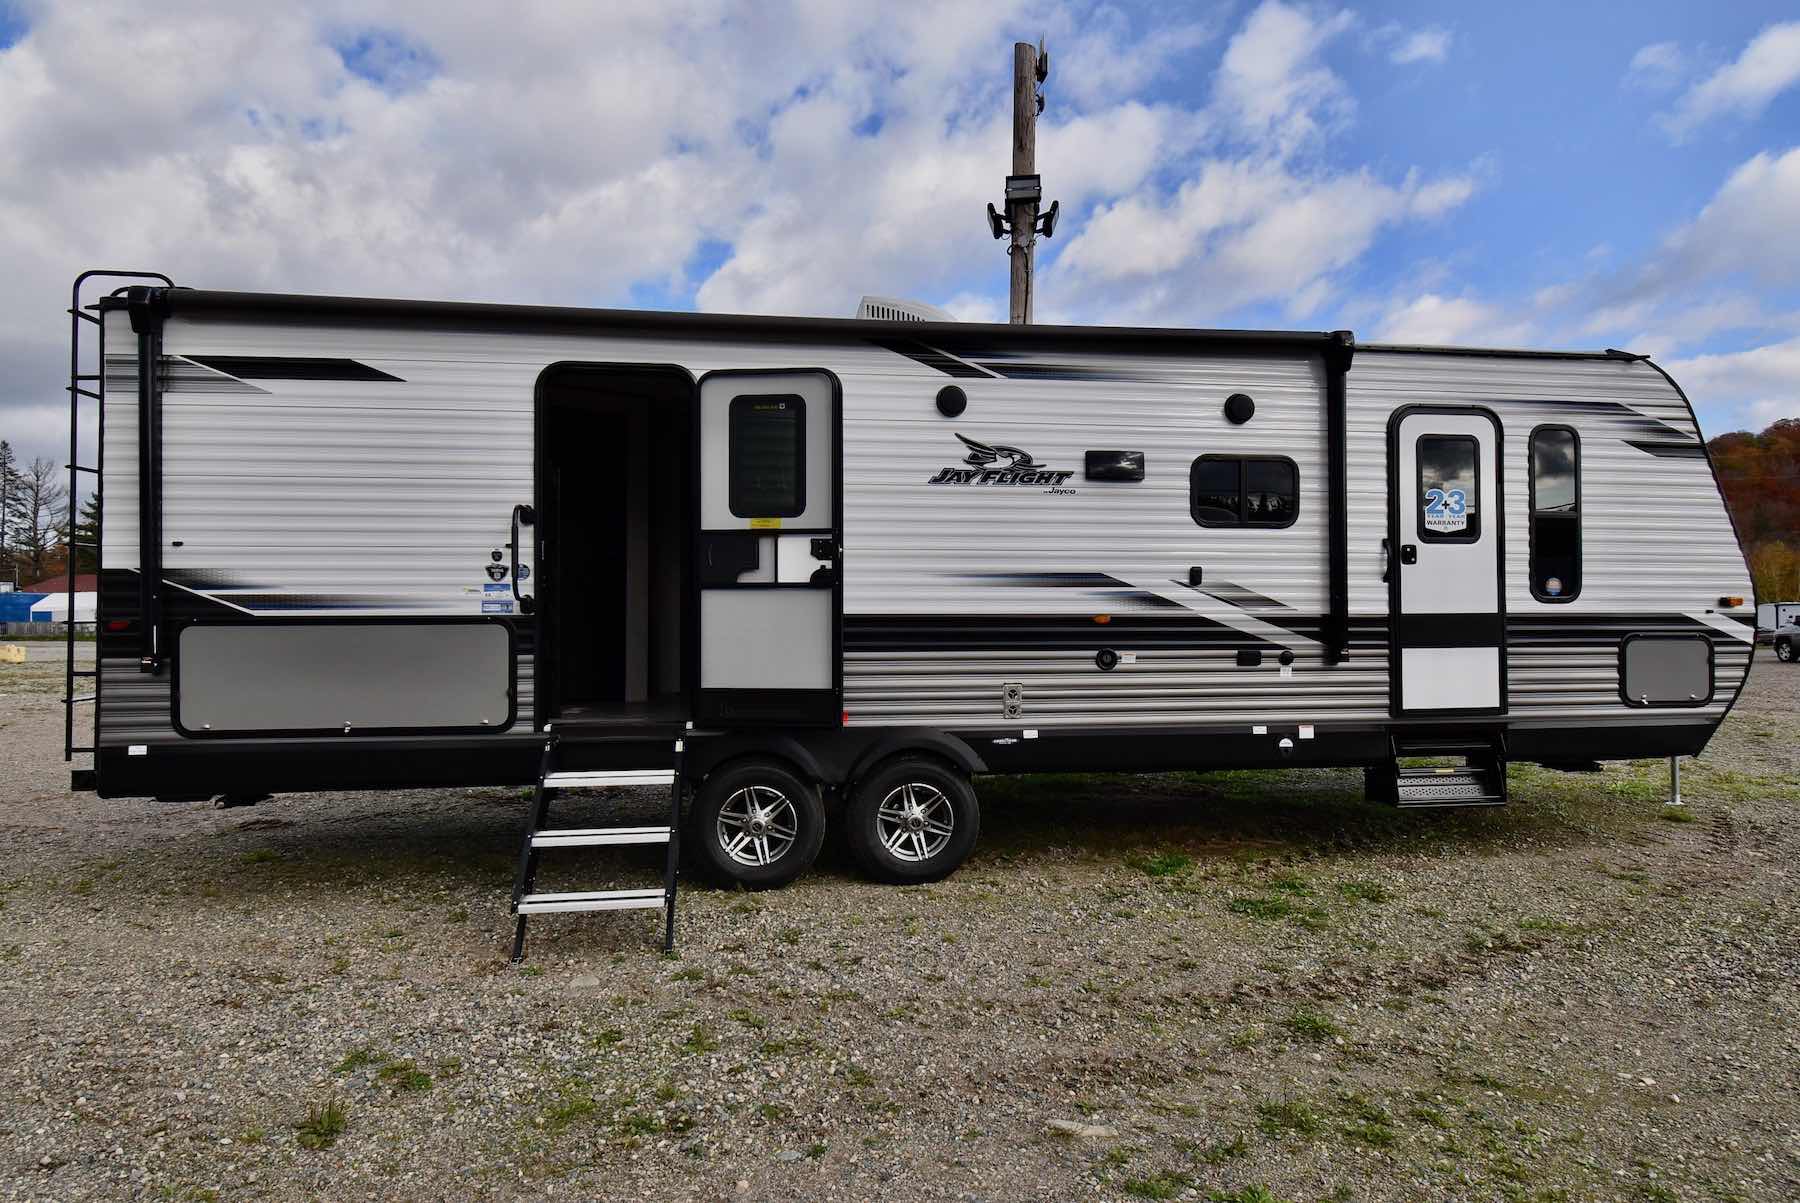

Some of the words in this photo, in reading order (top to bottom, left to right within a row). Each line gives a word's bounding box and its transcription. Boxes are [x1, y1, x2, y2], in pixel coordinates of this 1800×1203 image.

[928, 467, 980, 485] JAY
[977, 470, 1075, 486] FLIGHT
[1048, 487, 1076, 496] Jayco
